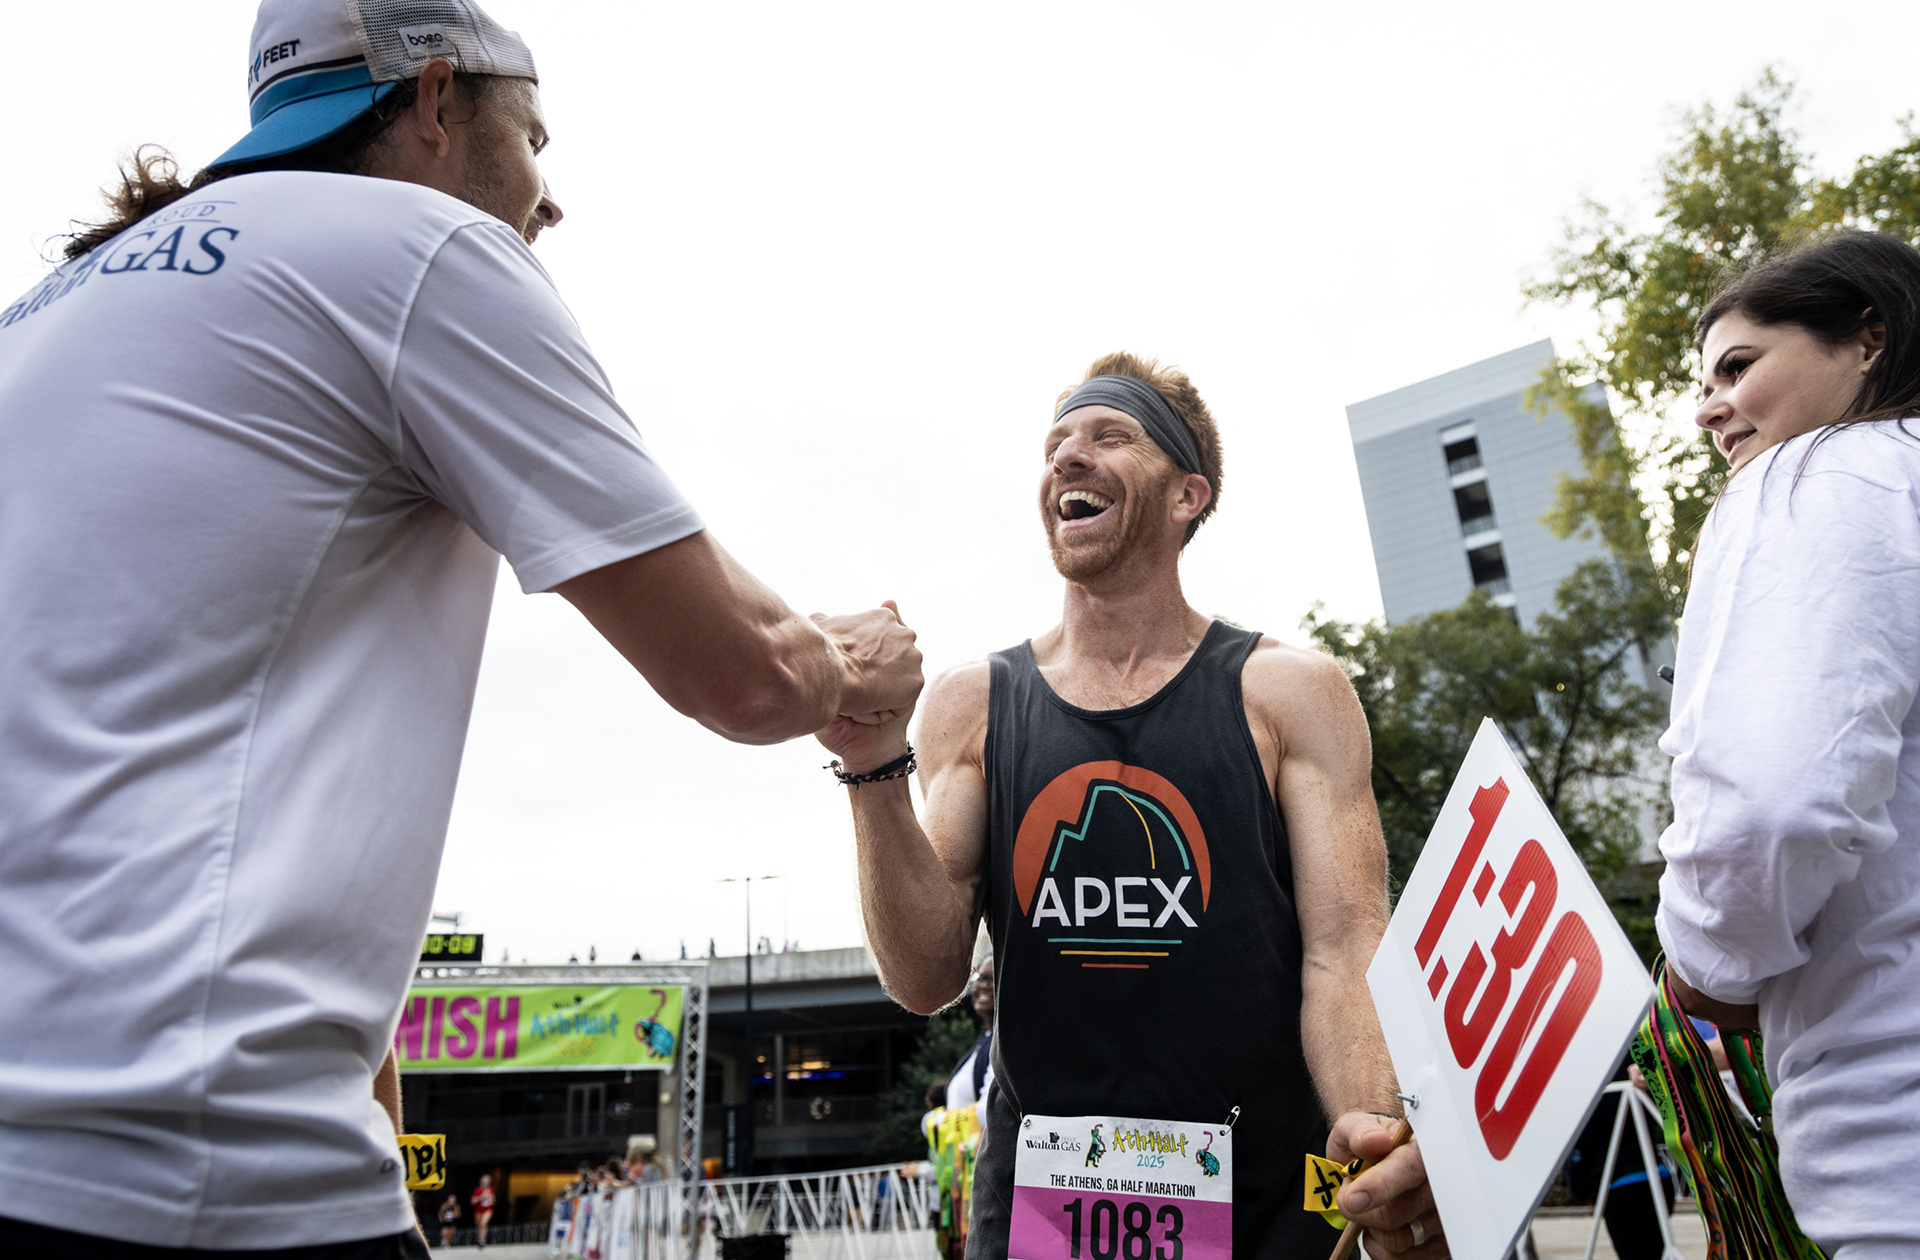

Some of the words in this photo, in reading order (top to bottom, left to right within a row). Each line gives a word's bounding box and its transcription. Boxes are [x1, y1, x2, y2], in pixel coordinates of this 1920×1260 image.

[263, 38, 300, 68] FEET
[149, 204, 216, 225] ROUD
[101, 225, 240, 275] GAS
[1032, 876, 1198, 928] APEX
[1414, 776, 1602, 1161] 1:30
[394, 996, 520, 1060] NISH
[1026, 1140, 1060, 1150] Walton
[1061, 1141, 1081, 1152] GAS
[1137, 1154, 1165, 1169] 2025
[1050, 1174, 1067, 1187] THE
[1068, 1176, 1105, 1191] ATHENS,
[1107, 1178, 1119, 1191] GA
[1120, 1179, 1144, 1193] HALF
[1145, 1181, 1196, 1197] MARATHON
[1063, 1197, 1184, 1260] 1083
